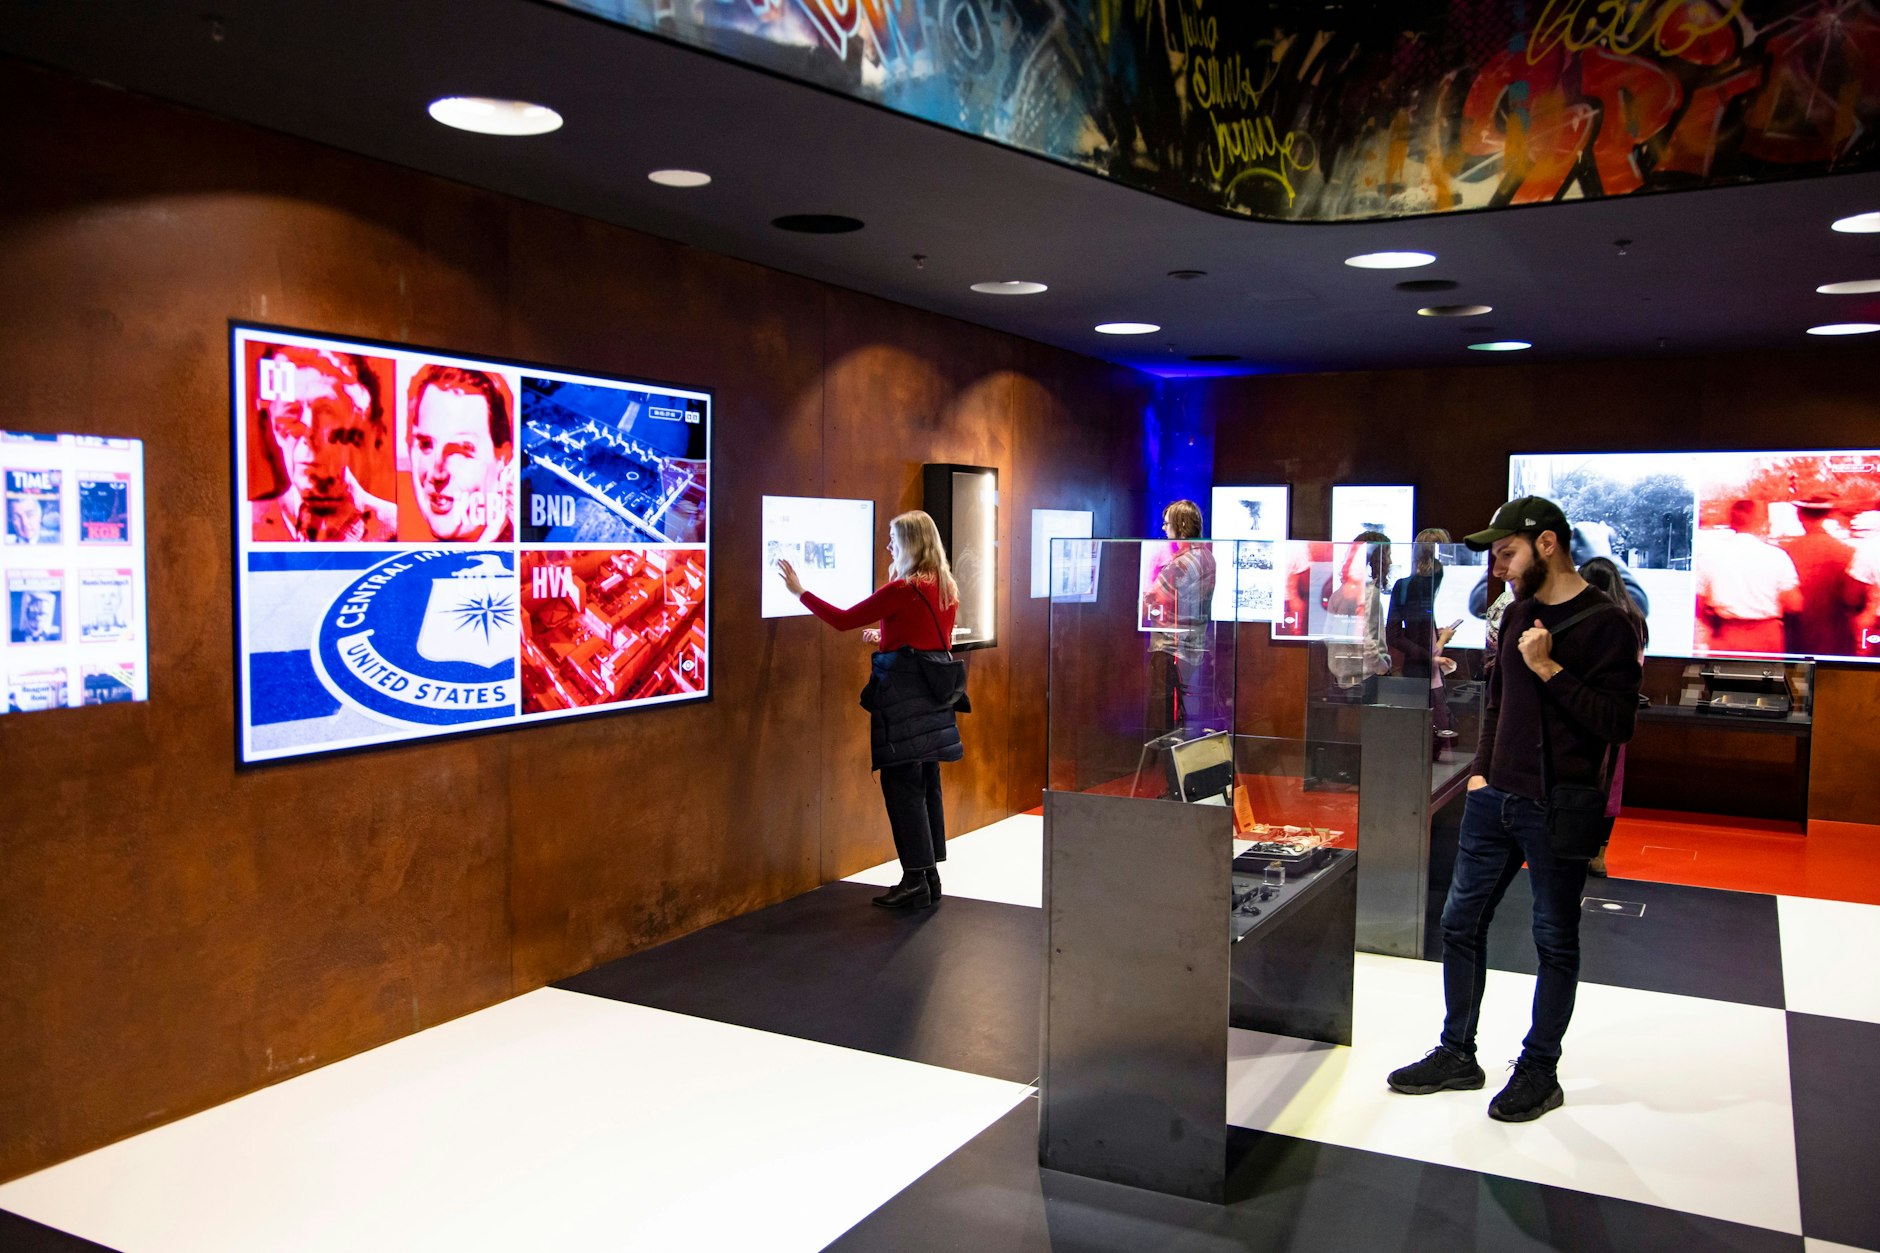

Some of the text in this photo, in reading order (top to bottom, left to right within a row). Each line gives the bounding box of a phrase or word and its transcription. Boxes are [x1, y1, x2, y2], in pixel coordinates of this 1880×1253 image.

[12, 471, 52, 490] TIME
[456, 491, 502, 527] KGB
[531, 494, 576, 527] BND
[336, 563, 413, 628] CENTRAL
[533, 566, 576, 599] HVA
[347, 643, 506, 704] UNITED STATES
